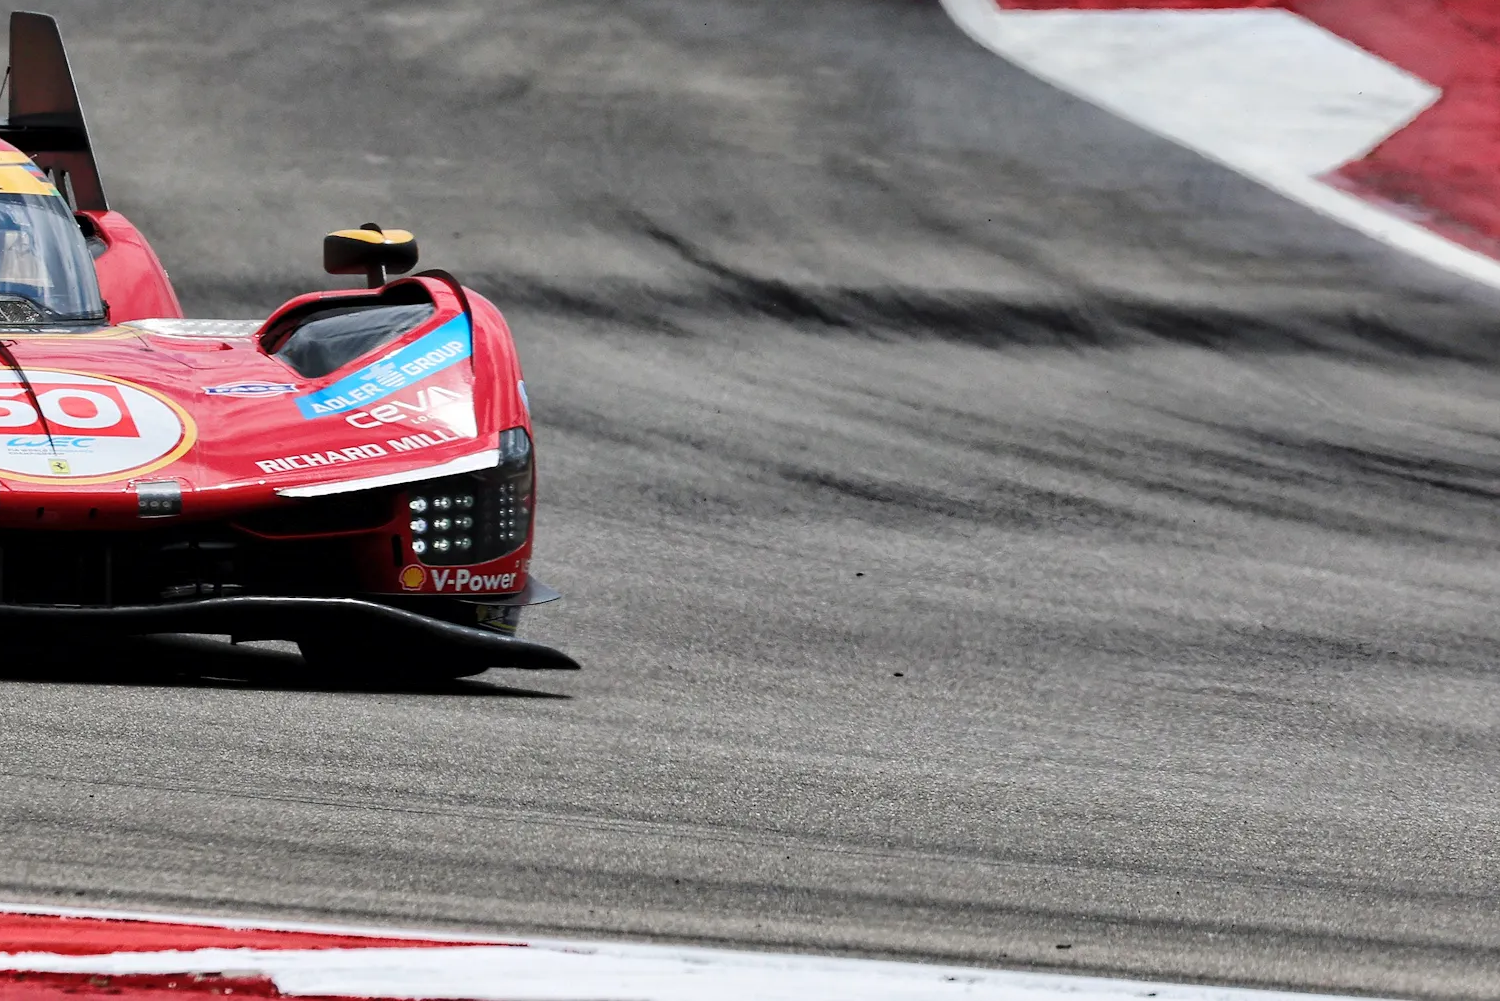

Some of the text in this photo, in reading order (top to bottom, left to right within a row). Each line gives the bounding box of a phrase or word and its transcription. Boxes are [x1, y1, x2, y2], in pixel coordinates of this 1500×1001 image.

[311, 340, 464, 414] ADLER GROUP
[6, 436, 97, 447] WEC
[255, 443, 387, 474] RICHARD
[430, 568, 517, 591] V-Power
